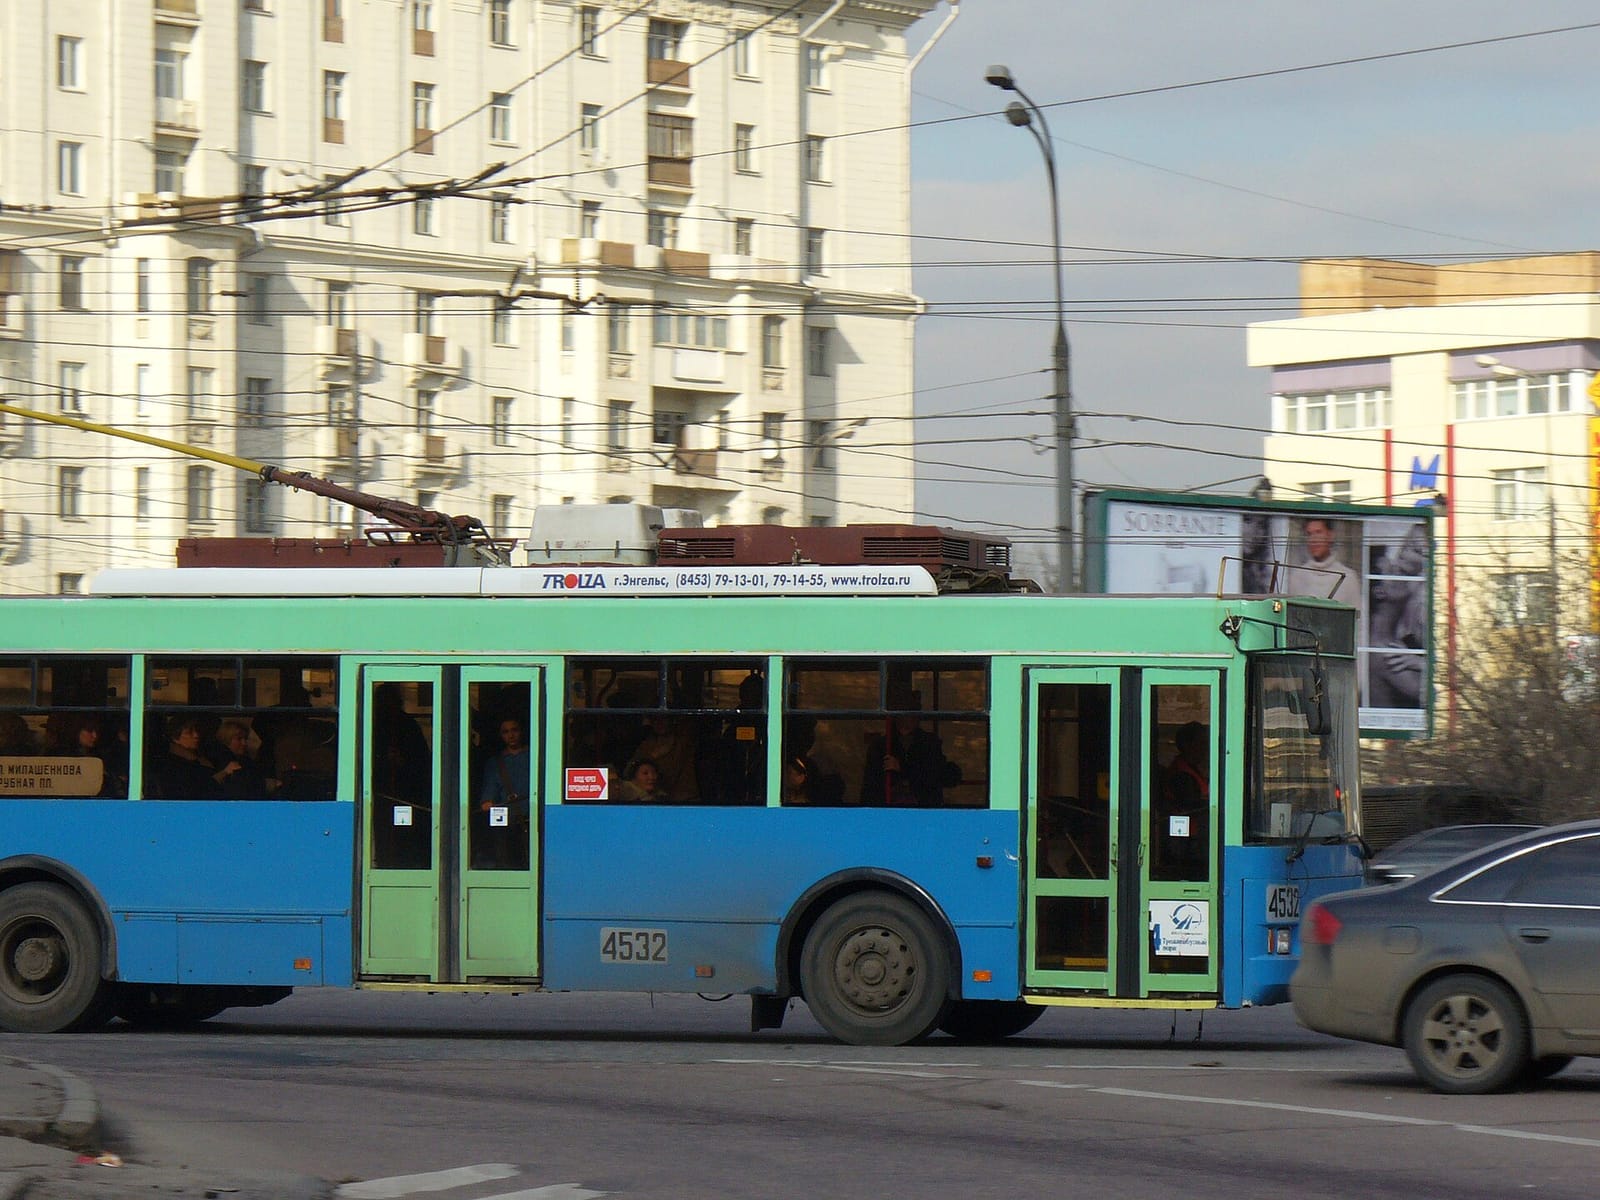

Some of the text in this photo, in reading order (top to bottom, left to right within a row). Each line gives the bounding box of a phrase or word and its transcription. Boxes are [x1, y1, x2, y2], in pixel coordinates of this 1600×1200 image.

[1123, 510, 1226, 535] SOBRANIE
[542, 573, 911, 589] TROLZA г.Энгельс, (8453) 79-13-01, 79-14-55, www.trolza.ru
[8, 764, 82, 776] МИЛАШЕНКОВА
[1268, 886, 1299, 919] 4532
[602, 931, 666, 961] 4532
